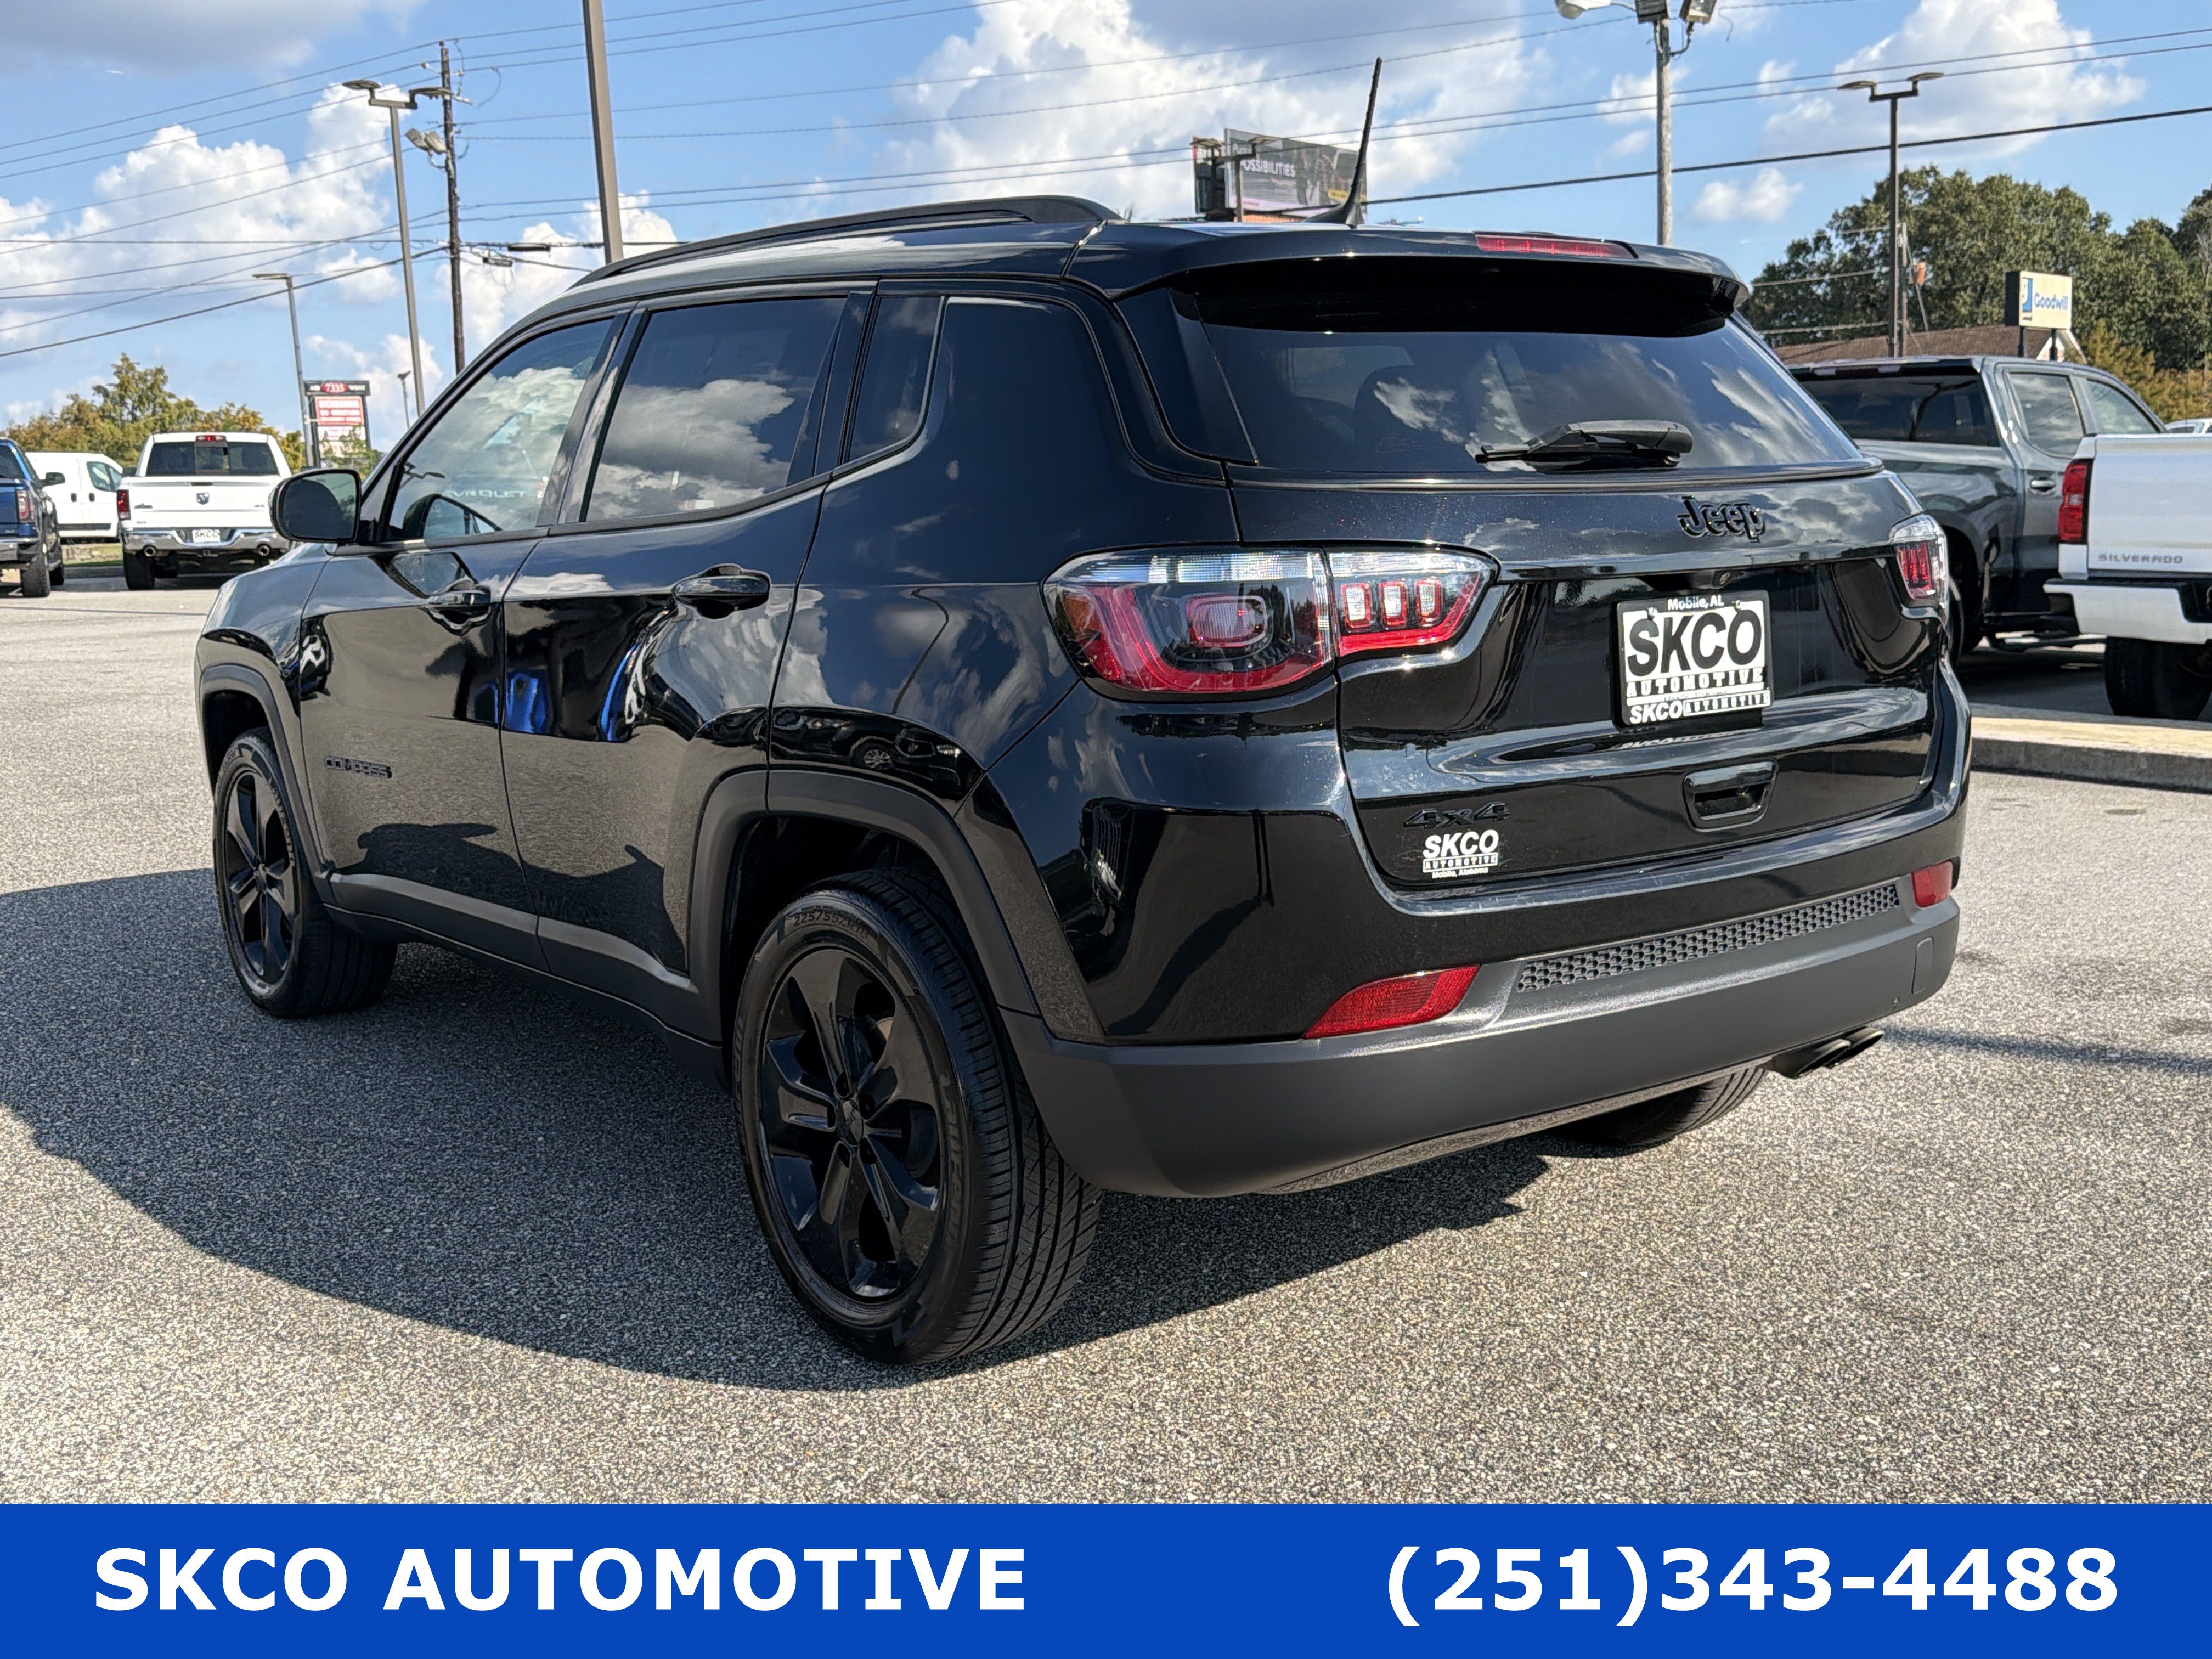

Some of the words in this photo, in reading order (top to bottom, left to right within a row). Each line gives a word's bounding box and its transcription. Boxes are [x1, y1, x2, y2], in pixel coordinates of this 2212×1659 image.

[1240, 157, 1296, 177] POSSIBILITIES
[1677, 496, 1765, 543] Jeep
[2098, 554, 2183, 564] SILVERADO
[1667, 596, 1708, 611] Mobile,
[1709, 595, 1725, 607] AL
[1627, 610, 1762, 676] SKCO
[1627, 667, 1763, 697] AUTOMOTIVE
[1629, 701, 1683, 724] SKCO
[1685, 692, 1770, 714] AUTOMOTIVE
[324, 755, 392, 778] COMPASS
[1423, 830, 1499, 859] SKCO
[1424, 855, 1497, 870] AUTOMOTIVE
